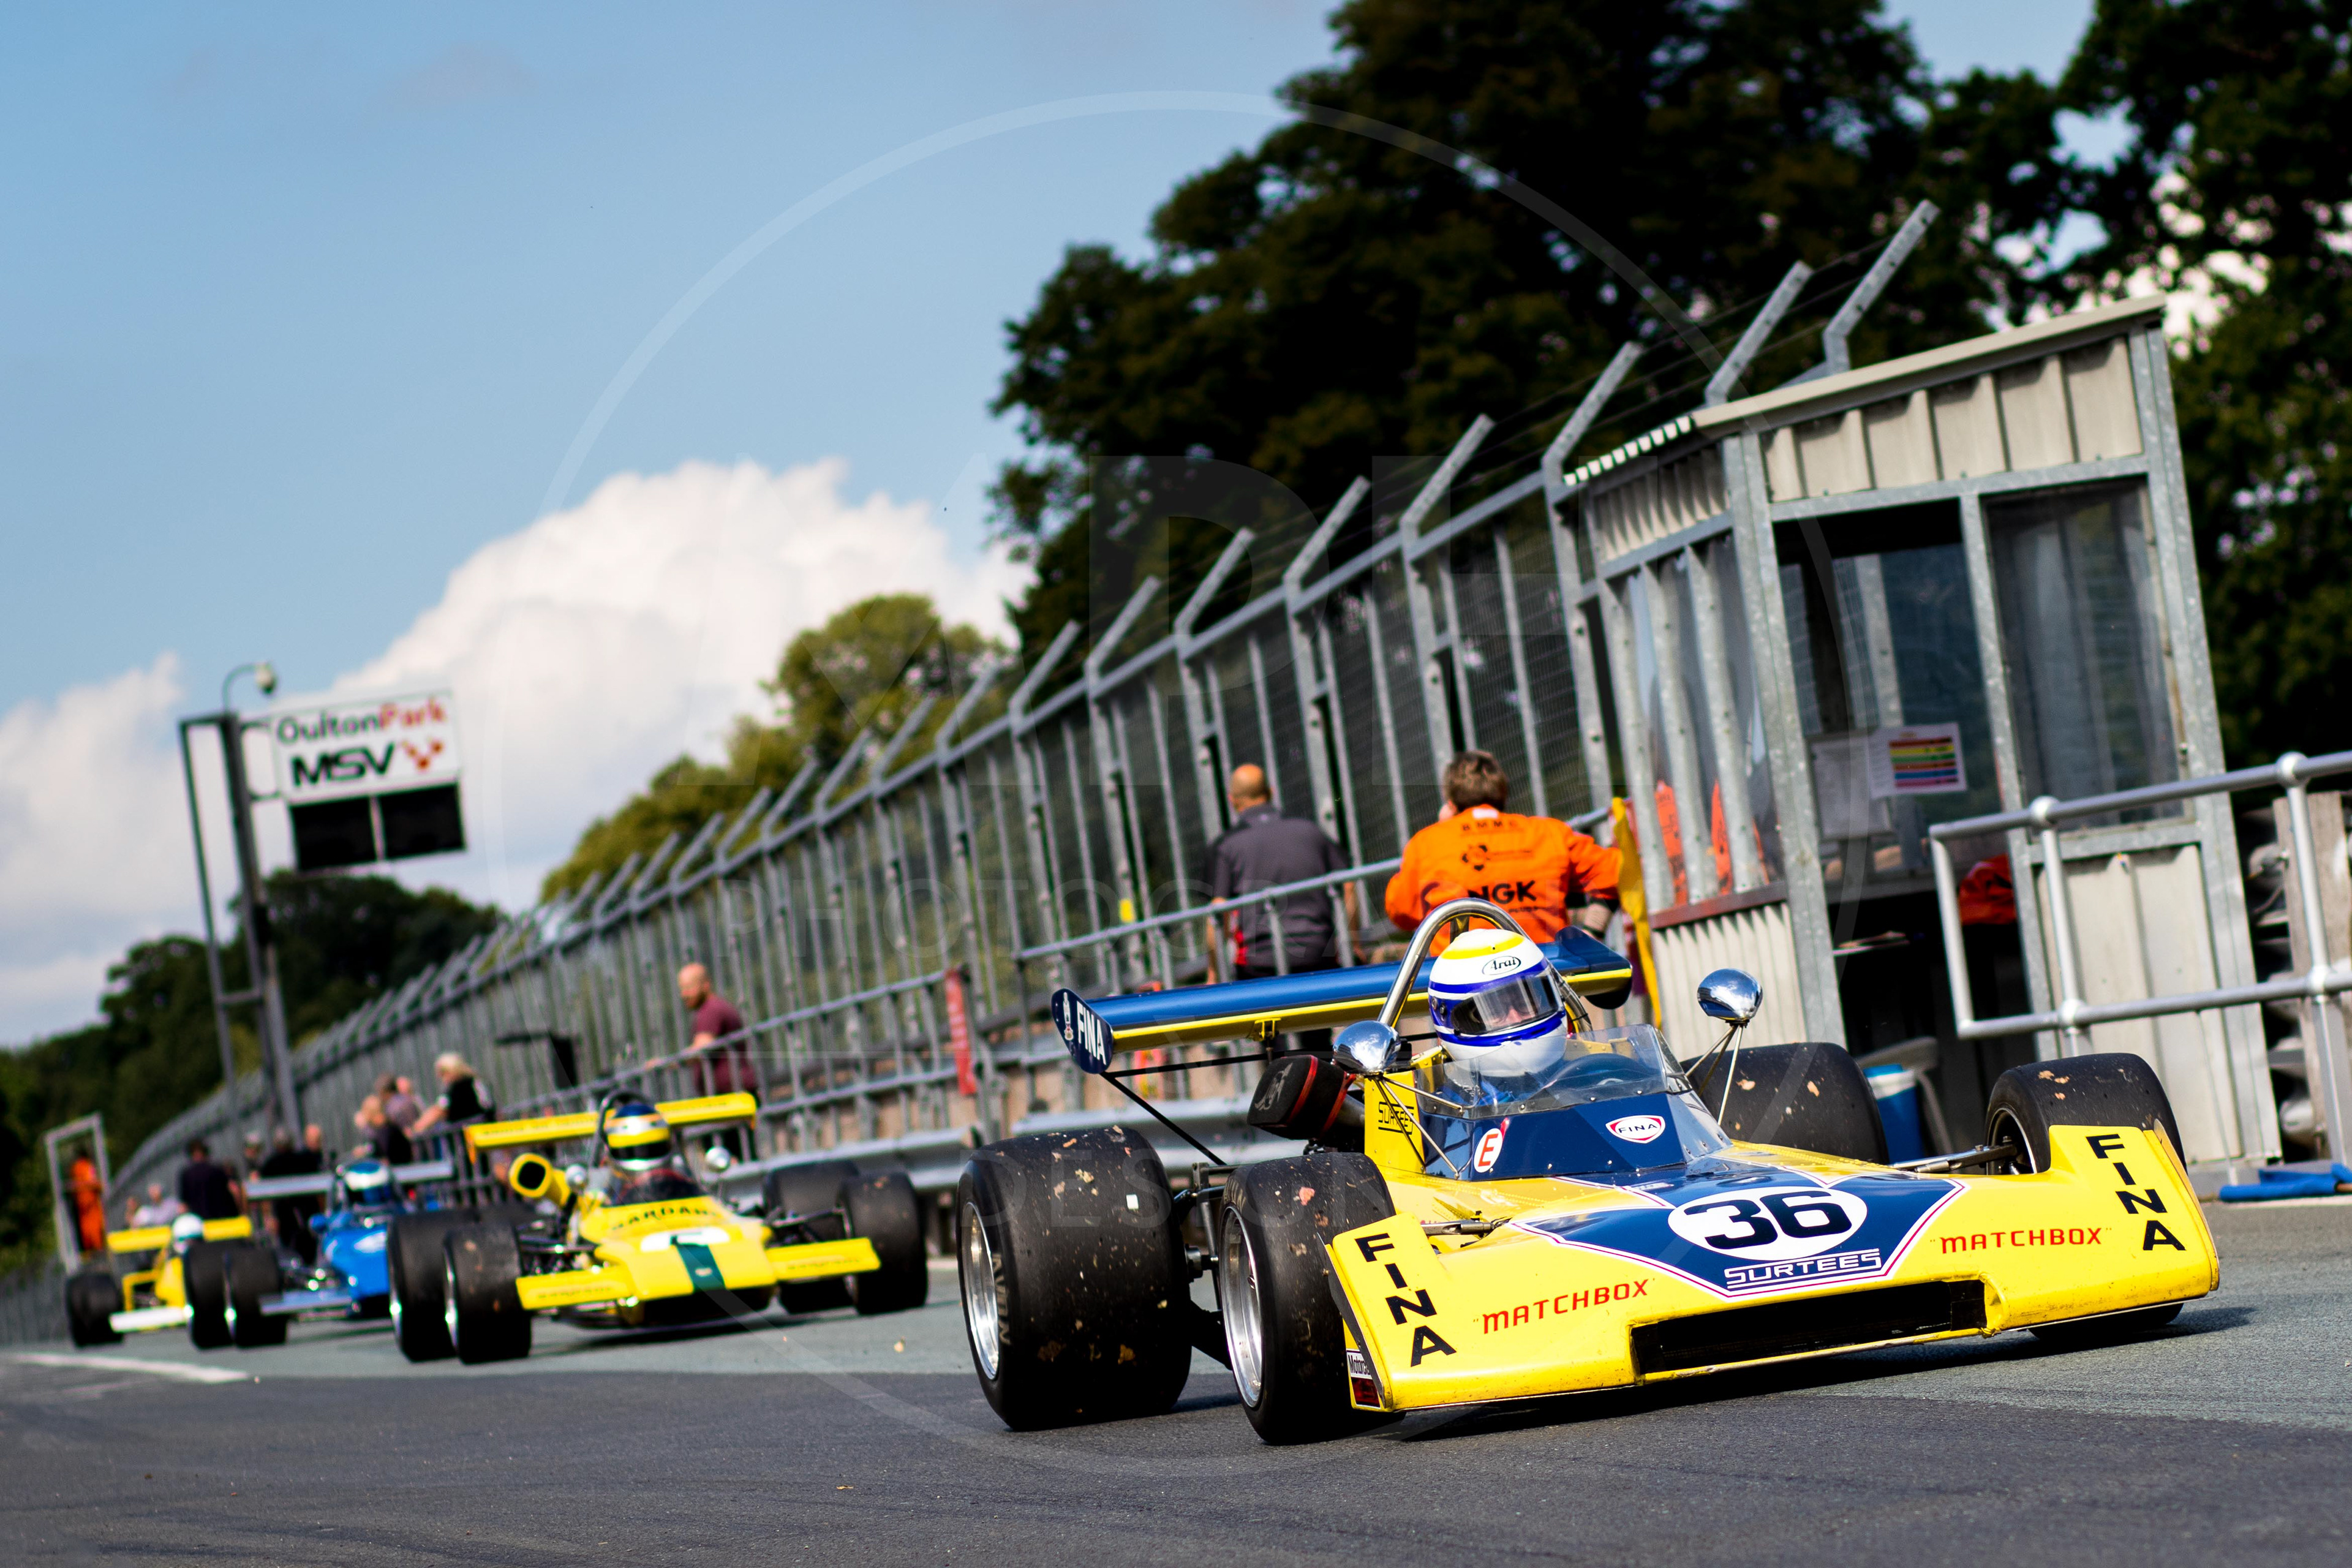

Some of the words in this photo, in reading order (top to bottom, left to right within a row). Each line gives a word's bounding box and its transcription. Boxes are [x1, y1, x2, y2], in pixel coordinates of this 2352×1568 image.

[290, 741, 396, 787] MSV
[1490, 957, 1517, 970] Arai
[1076, 1000, 1107, 1066] FINA
[1478, 1134, 1498, 1167] E
[1618, 1123, 1658, 1133] FINA
[2086, 1134, 2187, 1251] FINA
[1684, 1190, 1852, 1250] 36
[1724, 1248, 1882, 1289] SURTEES
[1354, 1232, 1457, 1368] FINA
